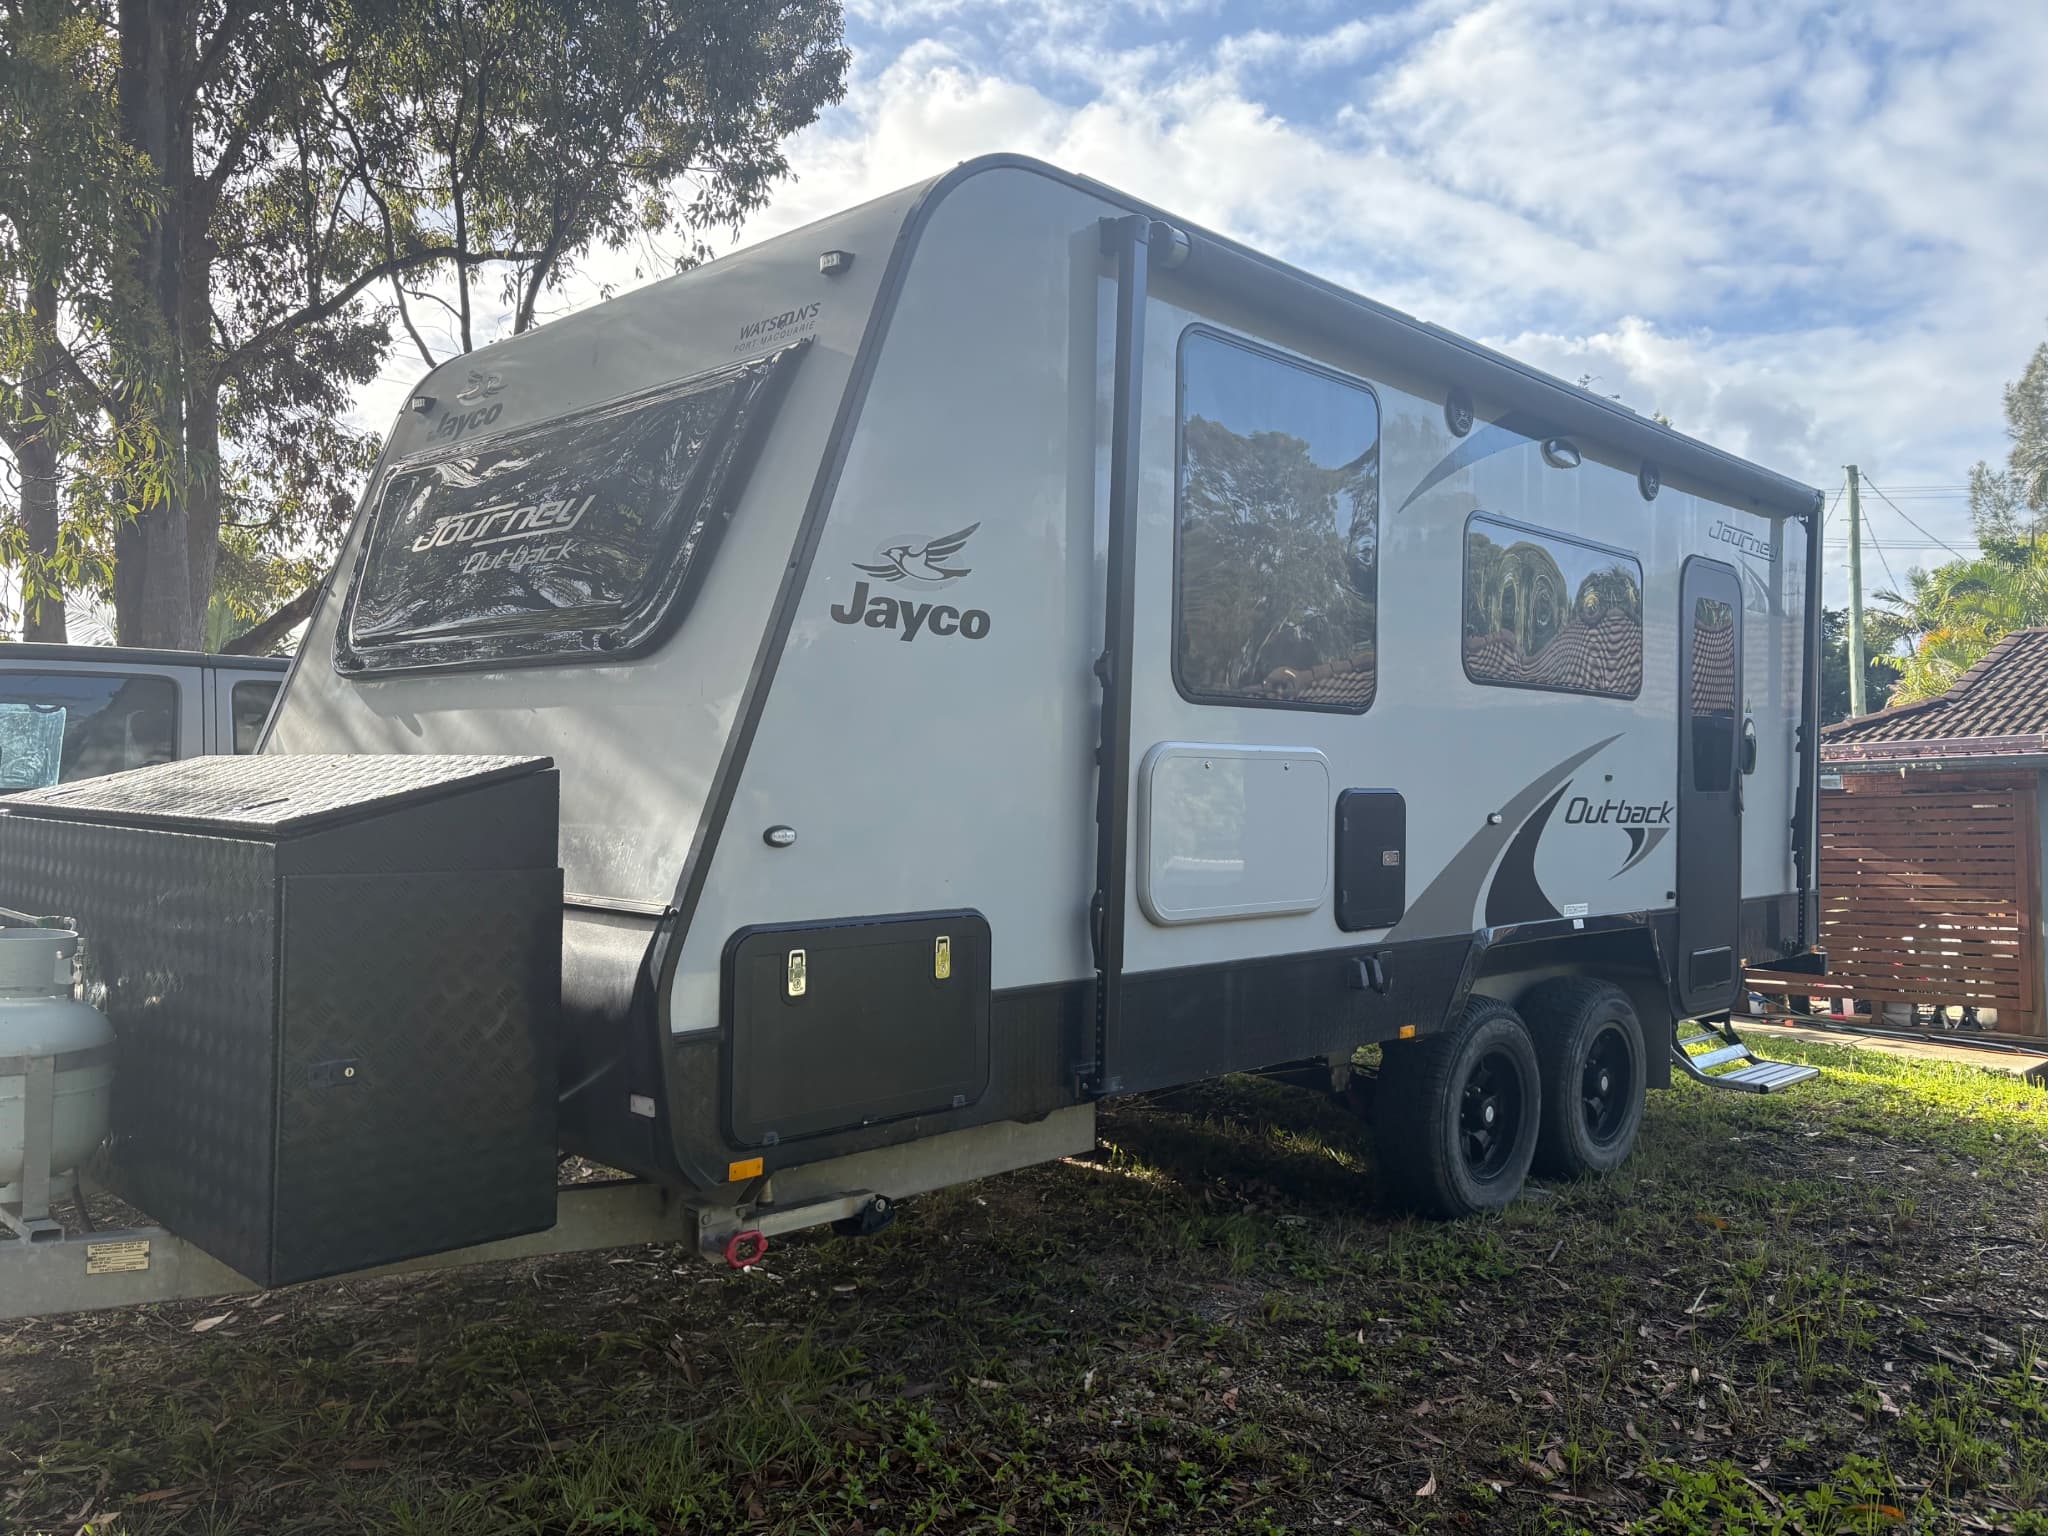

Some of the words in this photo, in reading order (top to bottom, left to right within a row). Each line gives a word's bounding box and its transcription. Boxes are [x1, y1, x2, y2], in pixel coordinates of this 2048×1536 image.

[426, 402, 503, 441] Jayco
[412, 494, 597, 552] Journey
[463, 537, 580, 574] Outback
[831, 581, 991, 642] Jayco
[1565, 797, 1675, 824] Outback
